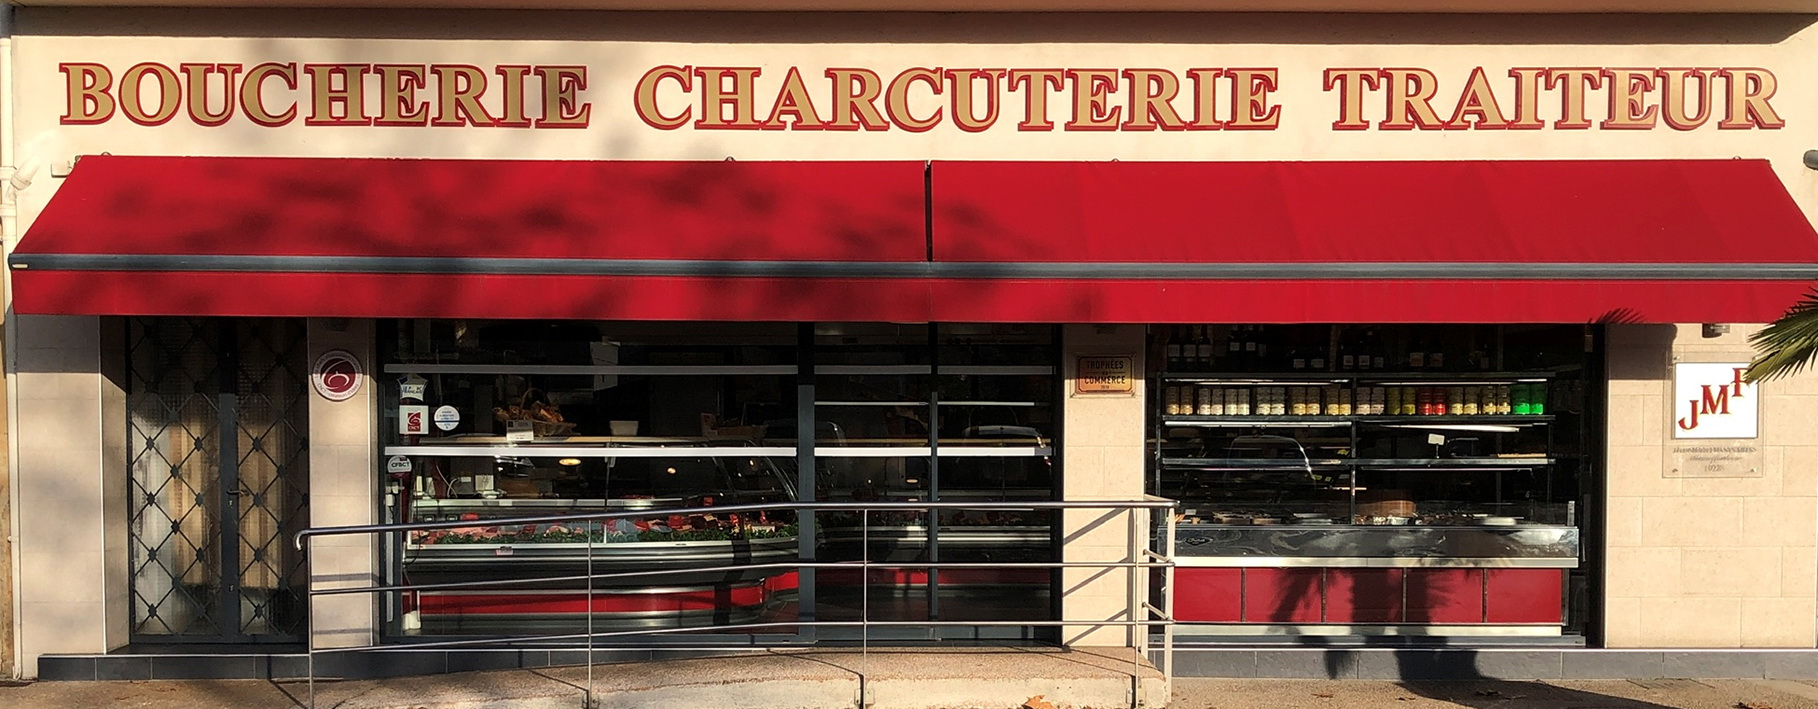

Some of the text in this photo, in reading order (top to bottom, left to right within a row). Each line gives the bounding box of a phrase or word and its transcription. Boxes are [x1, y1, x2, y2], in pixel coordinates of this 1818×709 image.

[59, 61, 1786, 133] BOUCHERIE CHARCUTERIE TRAITEUR
[1087, 360, 1124, 370] TROPHÉES
[1085, 376, 1126, 385] COMMERCE
